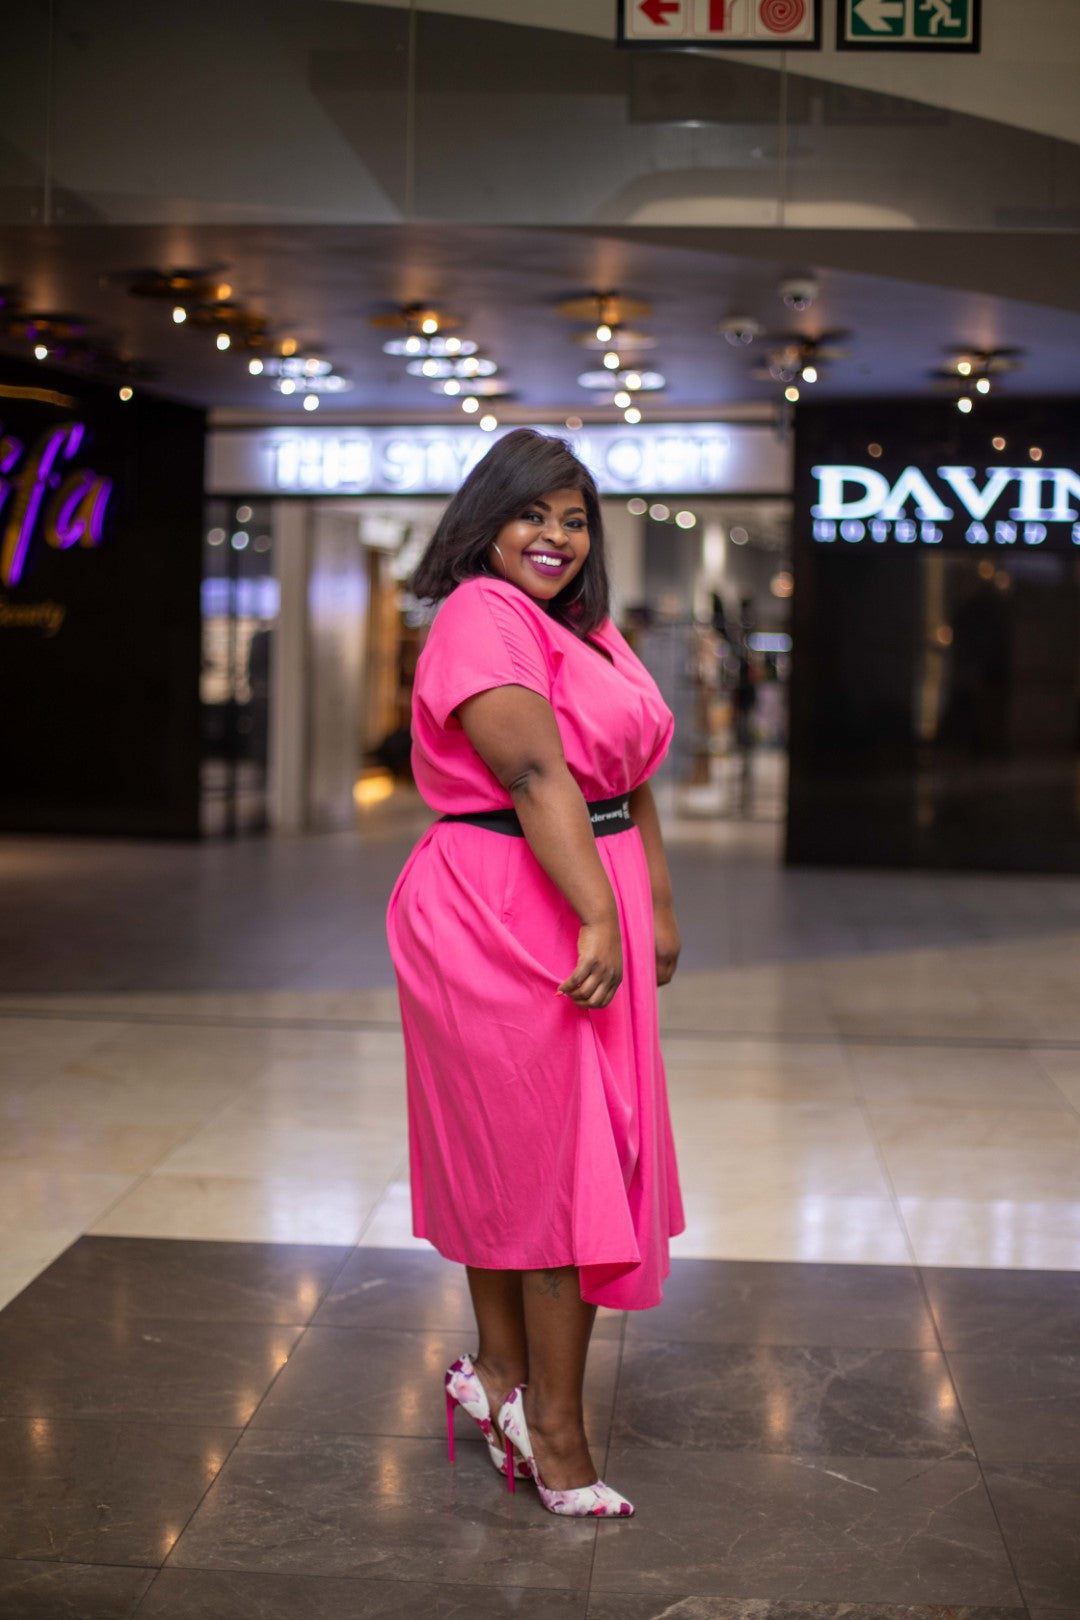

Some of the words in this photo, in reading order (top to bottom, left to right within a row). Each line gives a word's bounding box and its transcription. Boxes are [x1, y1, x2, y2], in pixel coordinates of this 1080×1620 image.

[261, 433, 371, 490] THE
[812, 518, 943, 543] HOTEL
[965, 520, 1047, 545] AND
